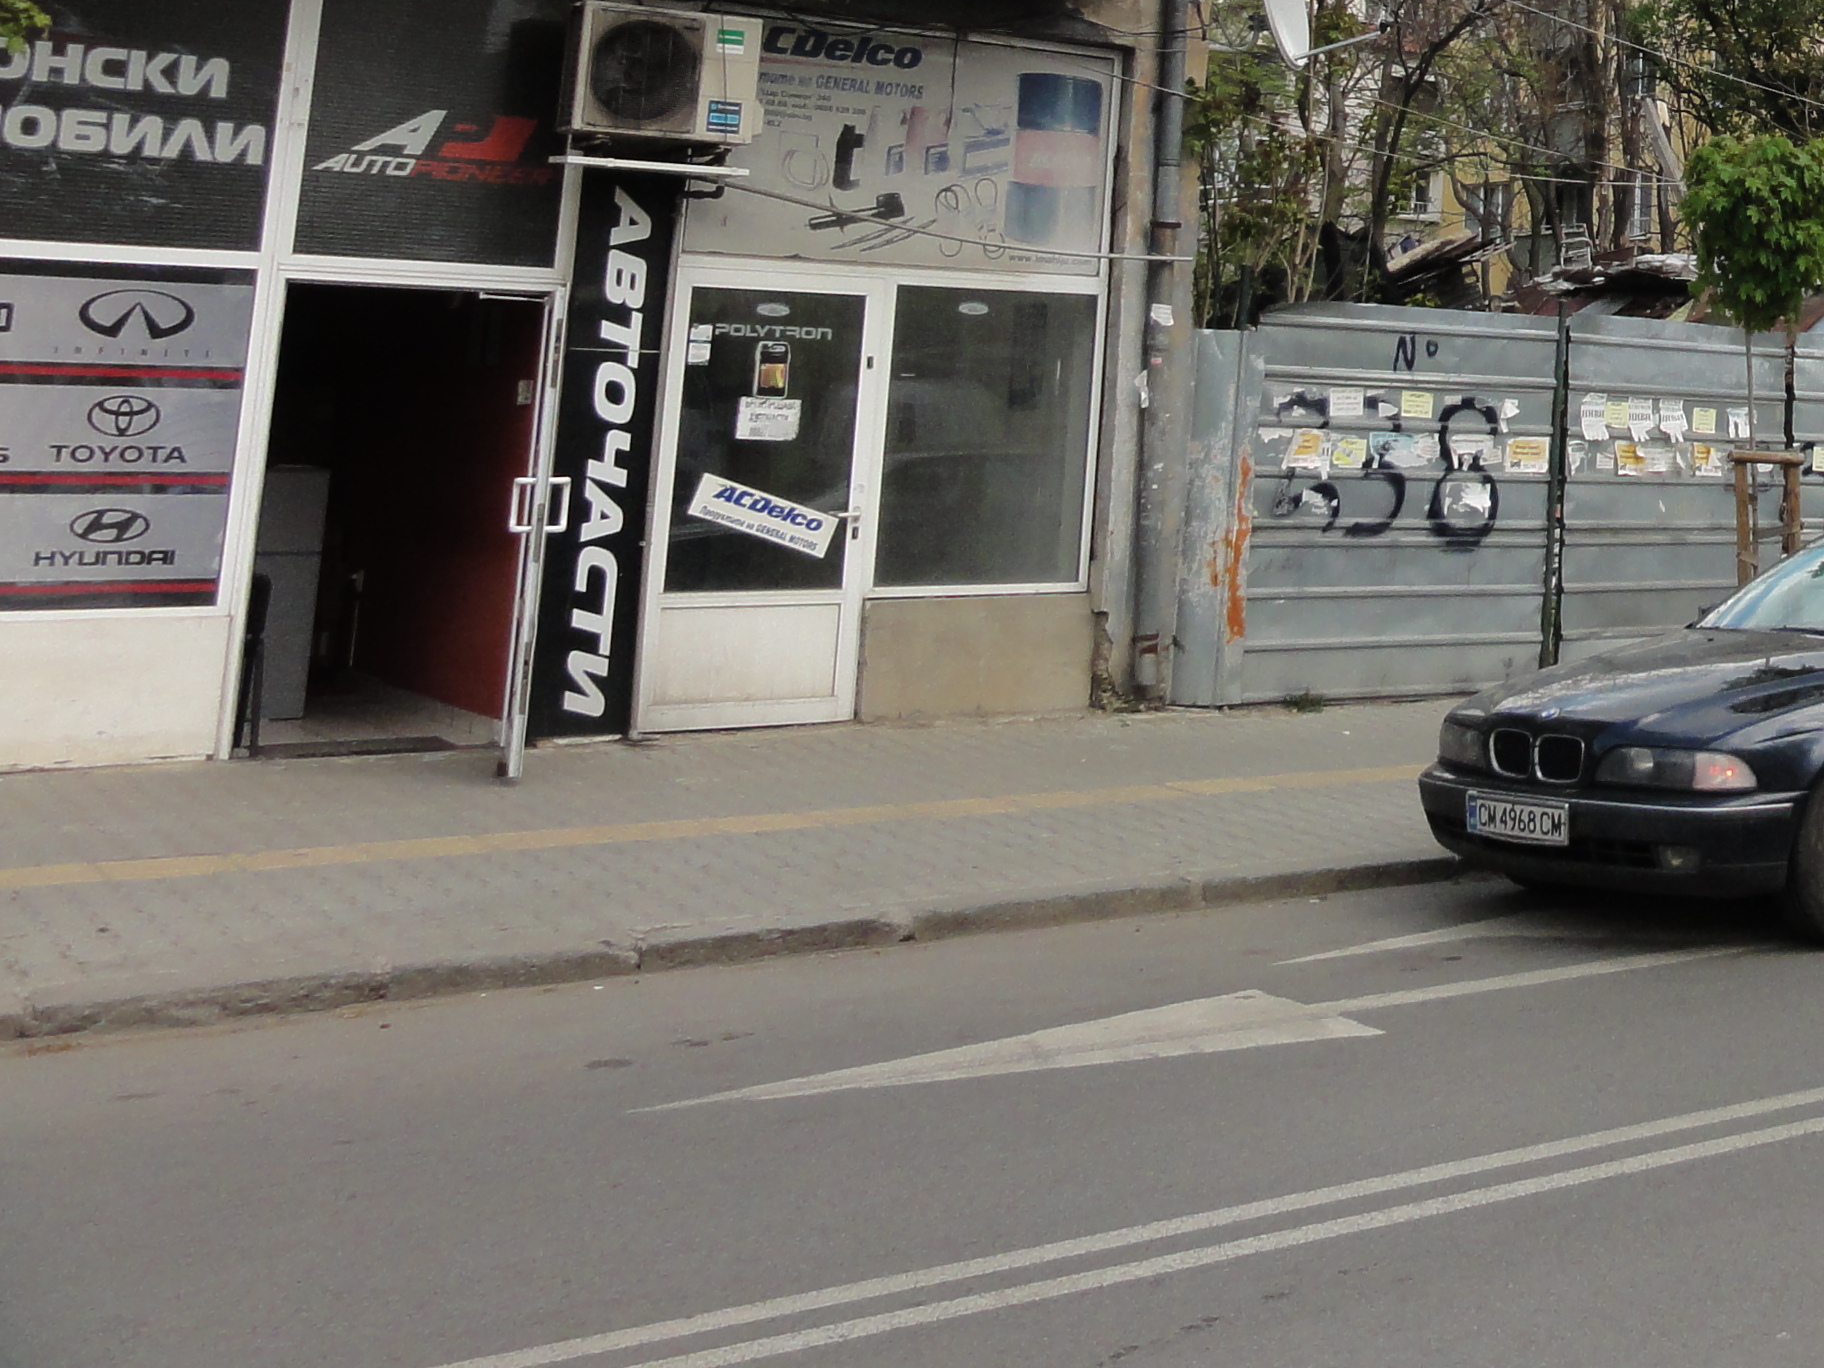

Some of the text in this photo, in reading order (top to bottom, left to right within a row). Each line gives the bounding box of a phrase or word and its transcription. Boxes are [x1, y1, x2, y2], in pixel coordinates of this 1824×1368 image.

[763, 26, 922, 69] CDelco
[815, 75, 870, 94] GENERAL
[874, 82, 924, 100] MOTORS
[0, 105, 266, 165] ОБИЛИ
[714, 323, 833, 340] POLYTRON
[50, 444, 188, 464] TOYOTA
[563, 185, 652, 718] АВТОЧАСТИ
[712, 484, 824, 532] ACDelco
[755, 523, 788, 541] GENERAL
[788, 534, 818, 551] MOTORS
[34, 549, 176, 568] HYUNDAI
[1479, 803, 1562, 837] CM 4968 CM
